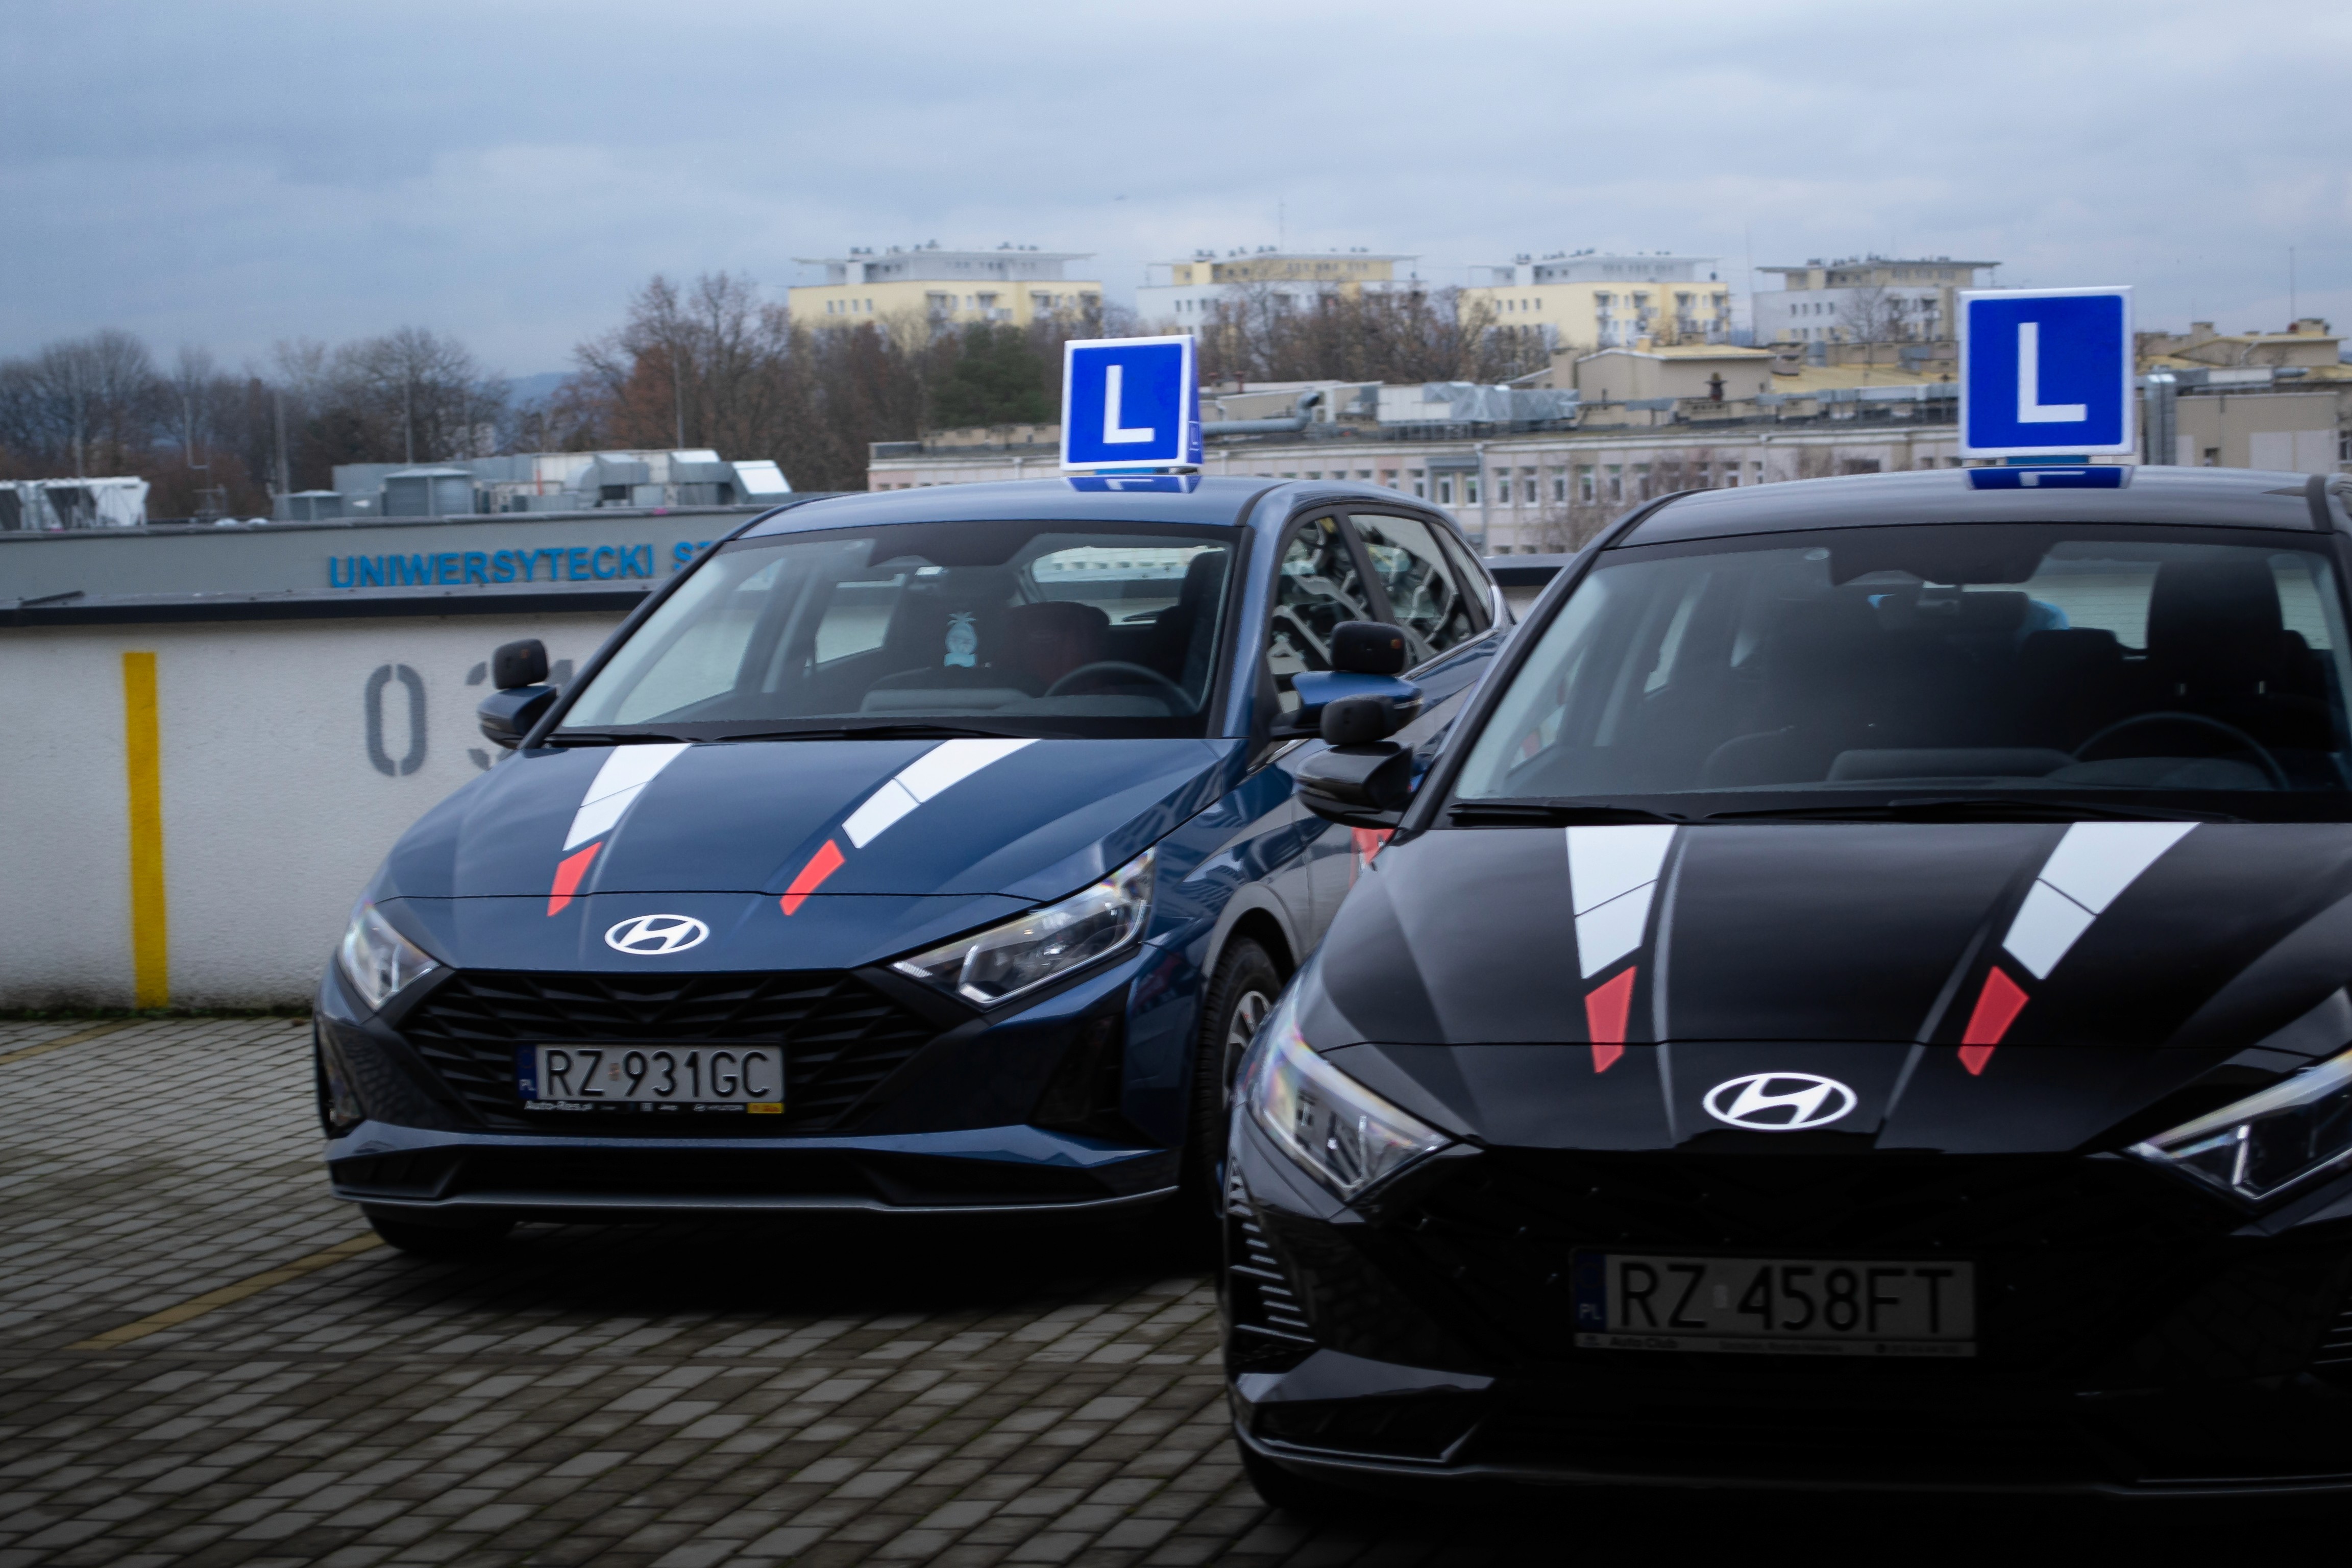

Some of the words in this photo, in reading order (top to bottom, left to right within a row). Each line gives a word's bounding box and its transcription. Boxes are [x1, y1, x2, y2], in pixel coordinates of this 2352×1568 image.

[2018, 322, 2087, 423] L
[1103, 364, 1155, 444] L
[329, 544, 654, 588] UNIWERSYTECKI
[673, 541, 714, 570] S
[545, 1049, 606, 1097] RZ
[622, 1050, 771, 1098] 931GC
[1578, 1303, 1602, 1320] PL
[1619, 1261, 1707, 1329] RZ
[1737, 1264, 1953, 1334] 458FT
